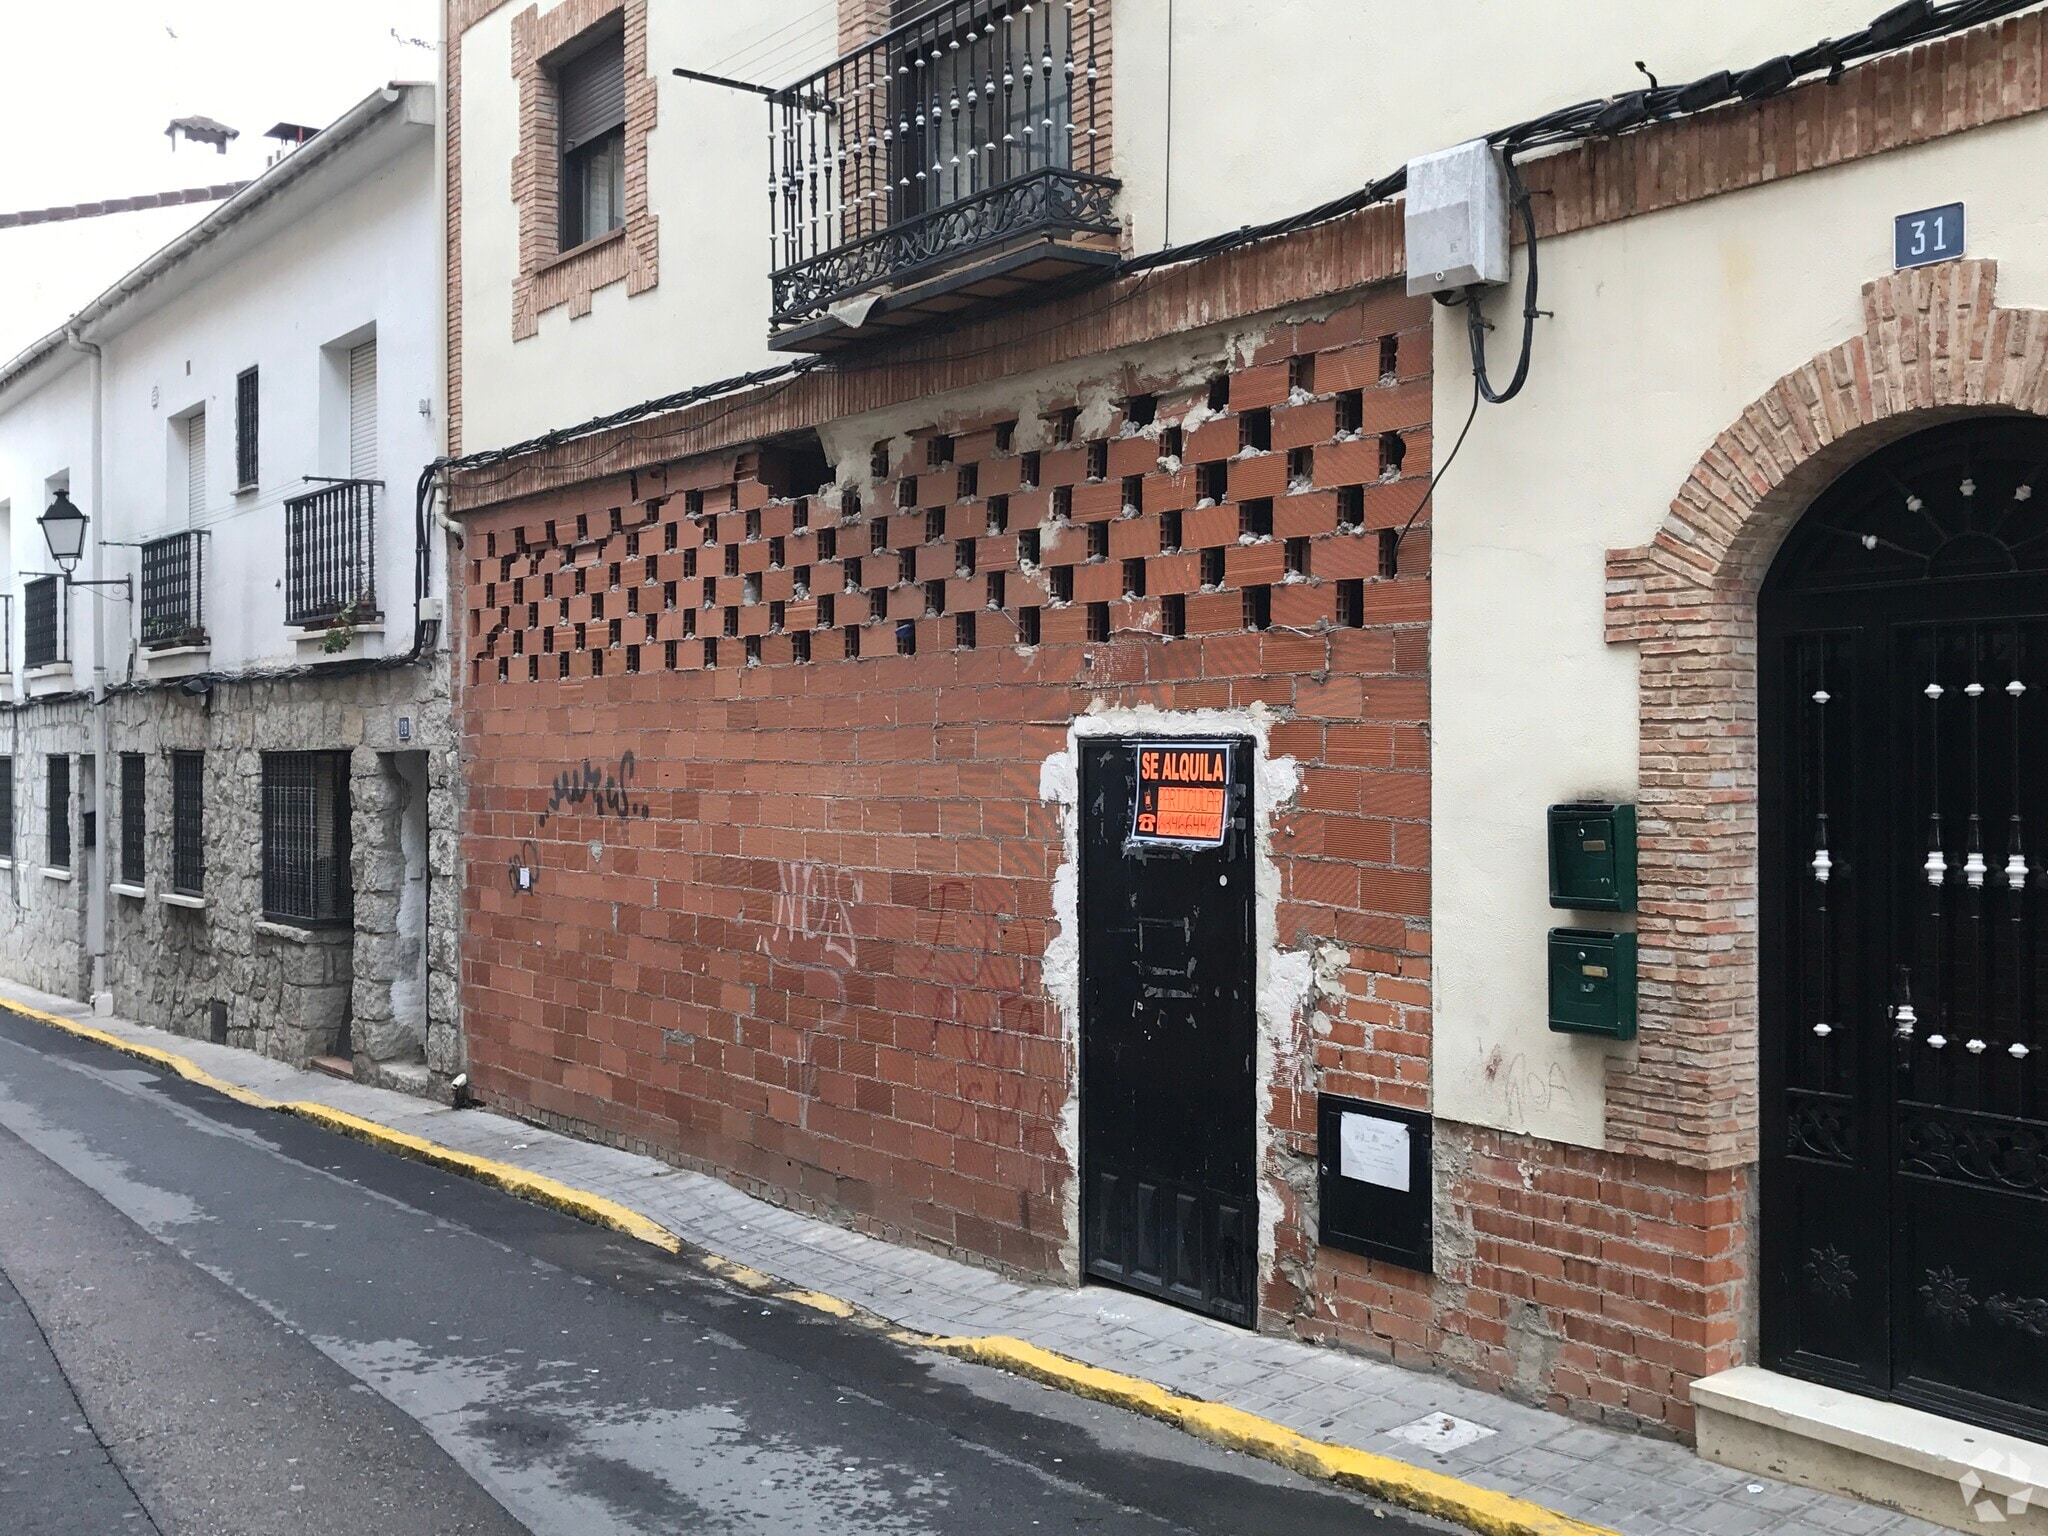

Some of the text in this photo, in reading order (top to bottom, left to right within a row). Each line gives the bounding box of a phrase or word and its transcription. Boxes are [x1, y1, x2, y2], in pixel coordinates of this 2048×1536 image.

[1911, 216, 1946, 256] 31
[1142, 752, 1224, 782] SE ALQUILA
[1160, 789, 1221, 812] PARTICULAR
